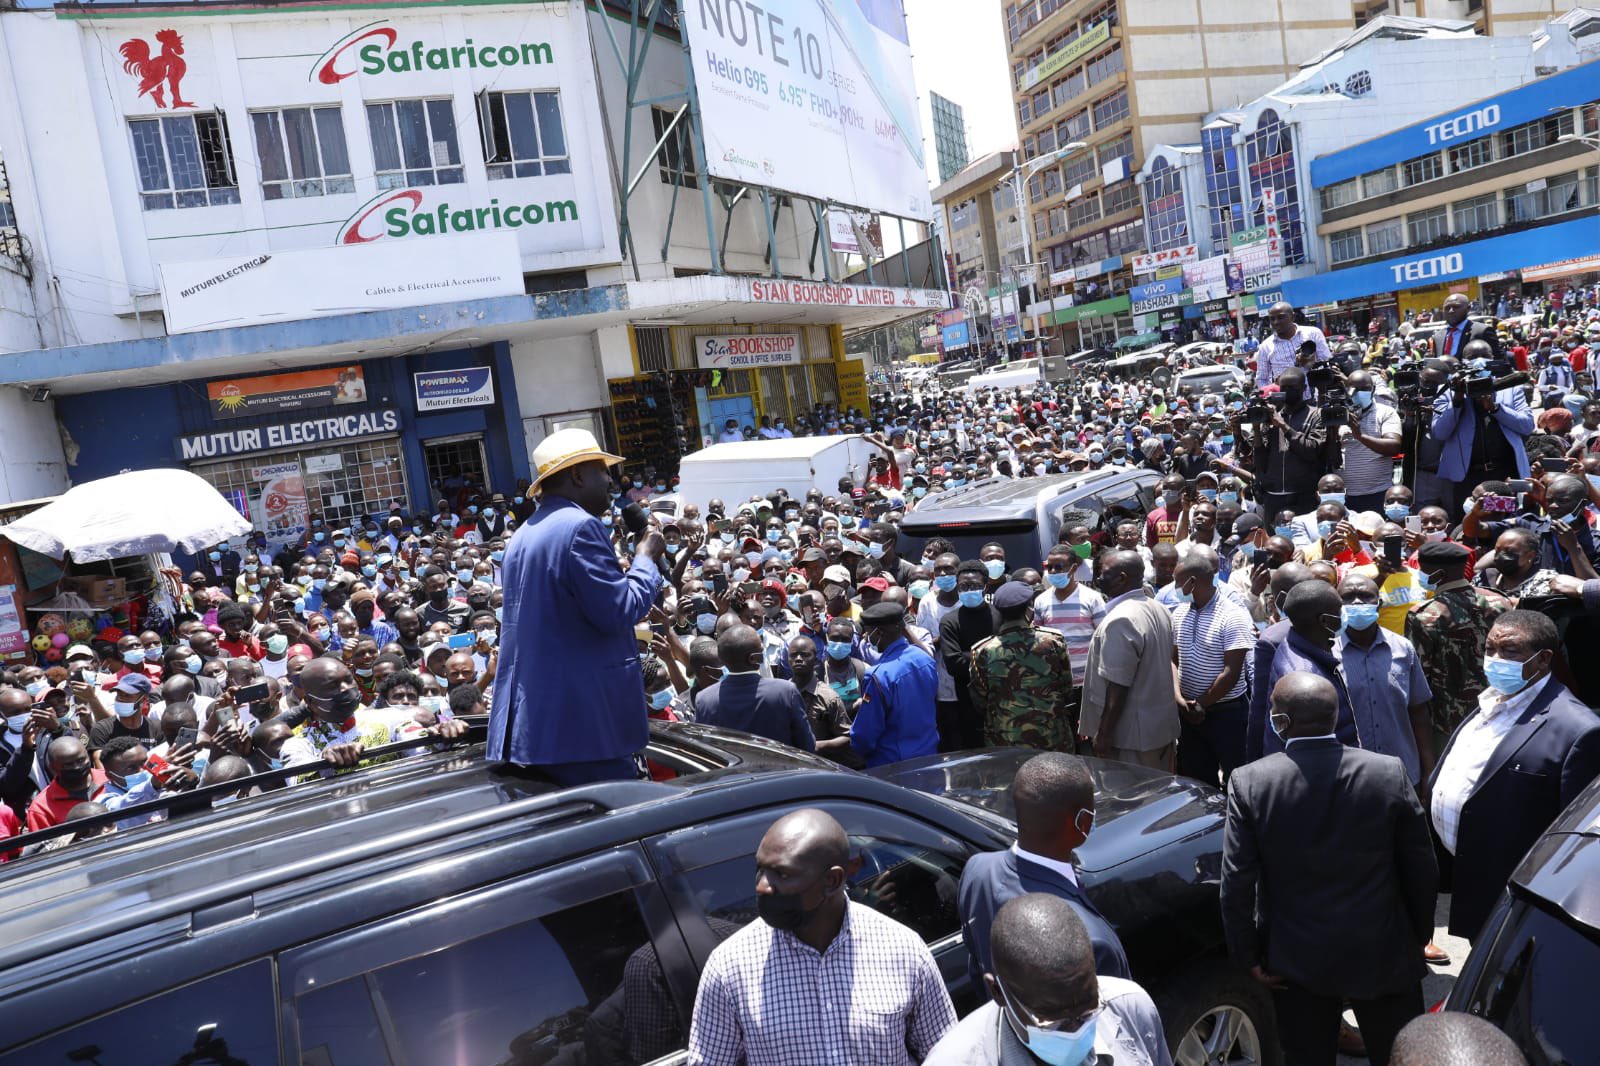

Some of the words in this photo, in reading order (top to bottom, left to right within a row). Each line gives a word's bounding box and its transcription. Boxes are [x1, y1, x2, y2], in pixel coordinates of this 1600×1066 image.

[359, 38, 553, 75] Safaricom
[700, 0, 789, 67] NOTE
[793, 26, 823, 81] 10
[827, 70, 856, 95] SERIES
[706, 49, 742, 84] Helio
[744, 67, 768, 95] G95
[874, 118, 897, 142] 64MP
[1424, 104, 1500, 145] TECNO
[385, 198, 579, 238] Safaricom
[1390, 252, 1463, 283] TECNO
[180, 277, 217, 298] MUTURI
[365, 286, 396, 296] Cables
[407, 279, 450, 291] Electrical
[451, 275, 502, 286] Accessories
[753, 281, 790, 300] STAN
[793, 284, 853, 304] BOOKSHOP
[857, 287, 896, 305] LIMITED
[1134, 295, 1175, 313] BIASHARA
[705, 339, 730, 356] Stan
[728, 336, 795, 355] BOOKSHOP
[731, 355, 750, 365] SCHOOL
[755, 354, 769, 363] OFFICE
[771, 353, 792, 362] SUPPLIES
[420, 375, 468, 387] POWERMAX
[426, 398, 451, 407] Muturi
[452, 394, 490, 404] Electricals
[180, 428, 262, 459] MUTURI
[267, 410, 398, 447] ELECTRICALS
[260, 464, 298, 476] PEDROLLO
